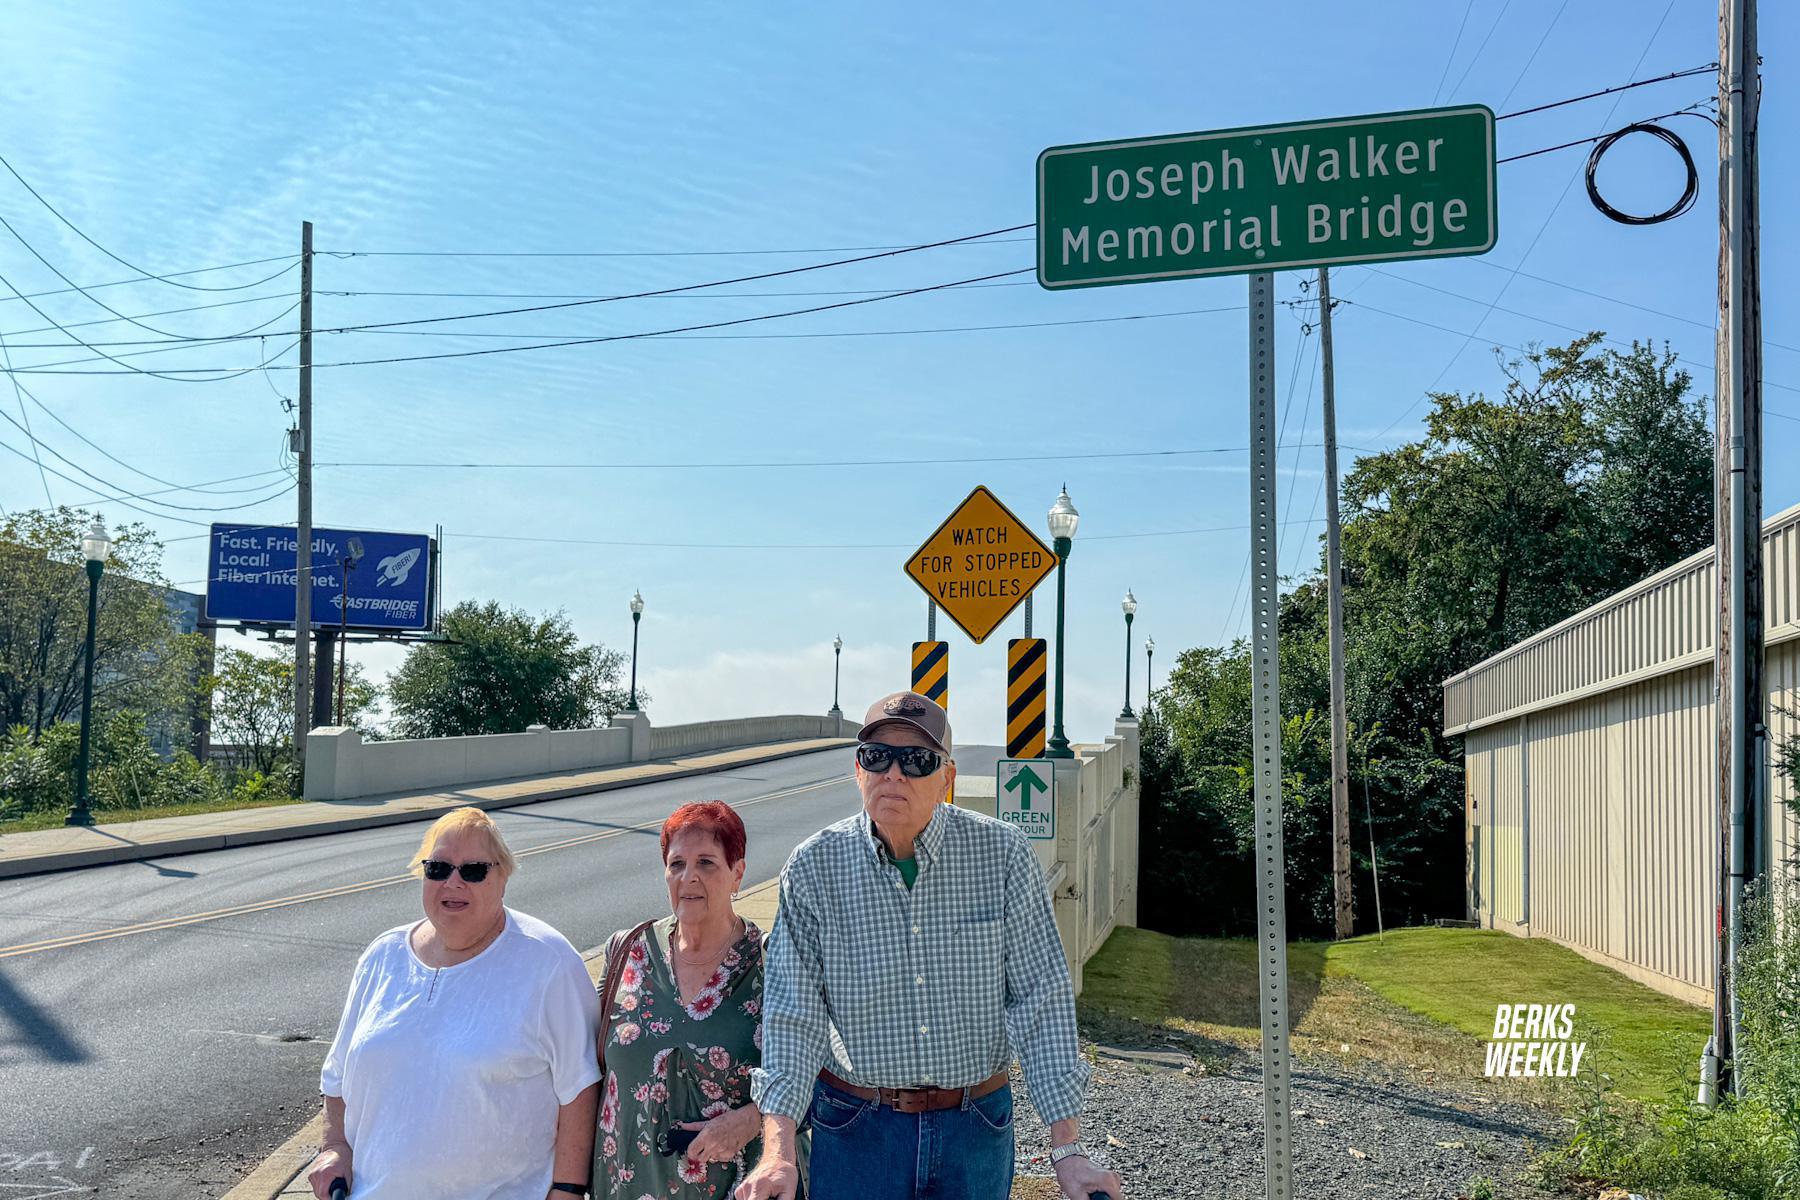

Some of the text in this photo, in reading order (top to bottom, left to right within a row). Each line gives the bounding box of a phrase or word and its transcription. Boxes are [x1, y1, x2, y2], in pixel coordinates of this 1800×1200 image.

[1083, 135, 1444, 205] Joseph Walker
[1061, 194, 1469, 266] Memorial Bridge
[220, 534, 339, 557] Fast. Friedly.
[952, 526, 1008, 546] WATCH
[219, 551, 270, 567] Local!
[921, 551, 1042, 574] FOR STOPPED
[218, 568, 339, 588] Fiber Intenet.
[938, 578, 1021, 599] VEHICLES
[385, 610, 417, 620] FIBER
[1002, 811, 1050, 824] GREEN
[1019, 825, 1045, 834] TOUR
